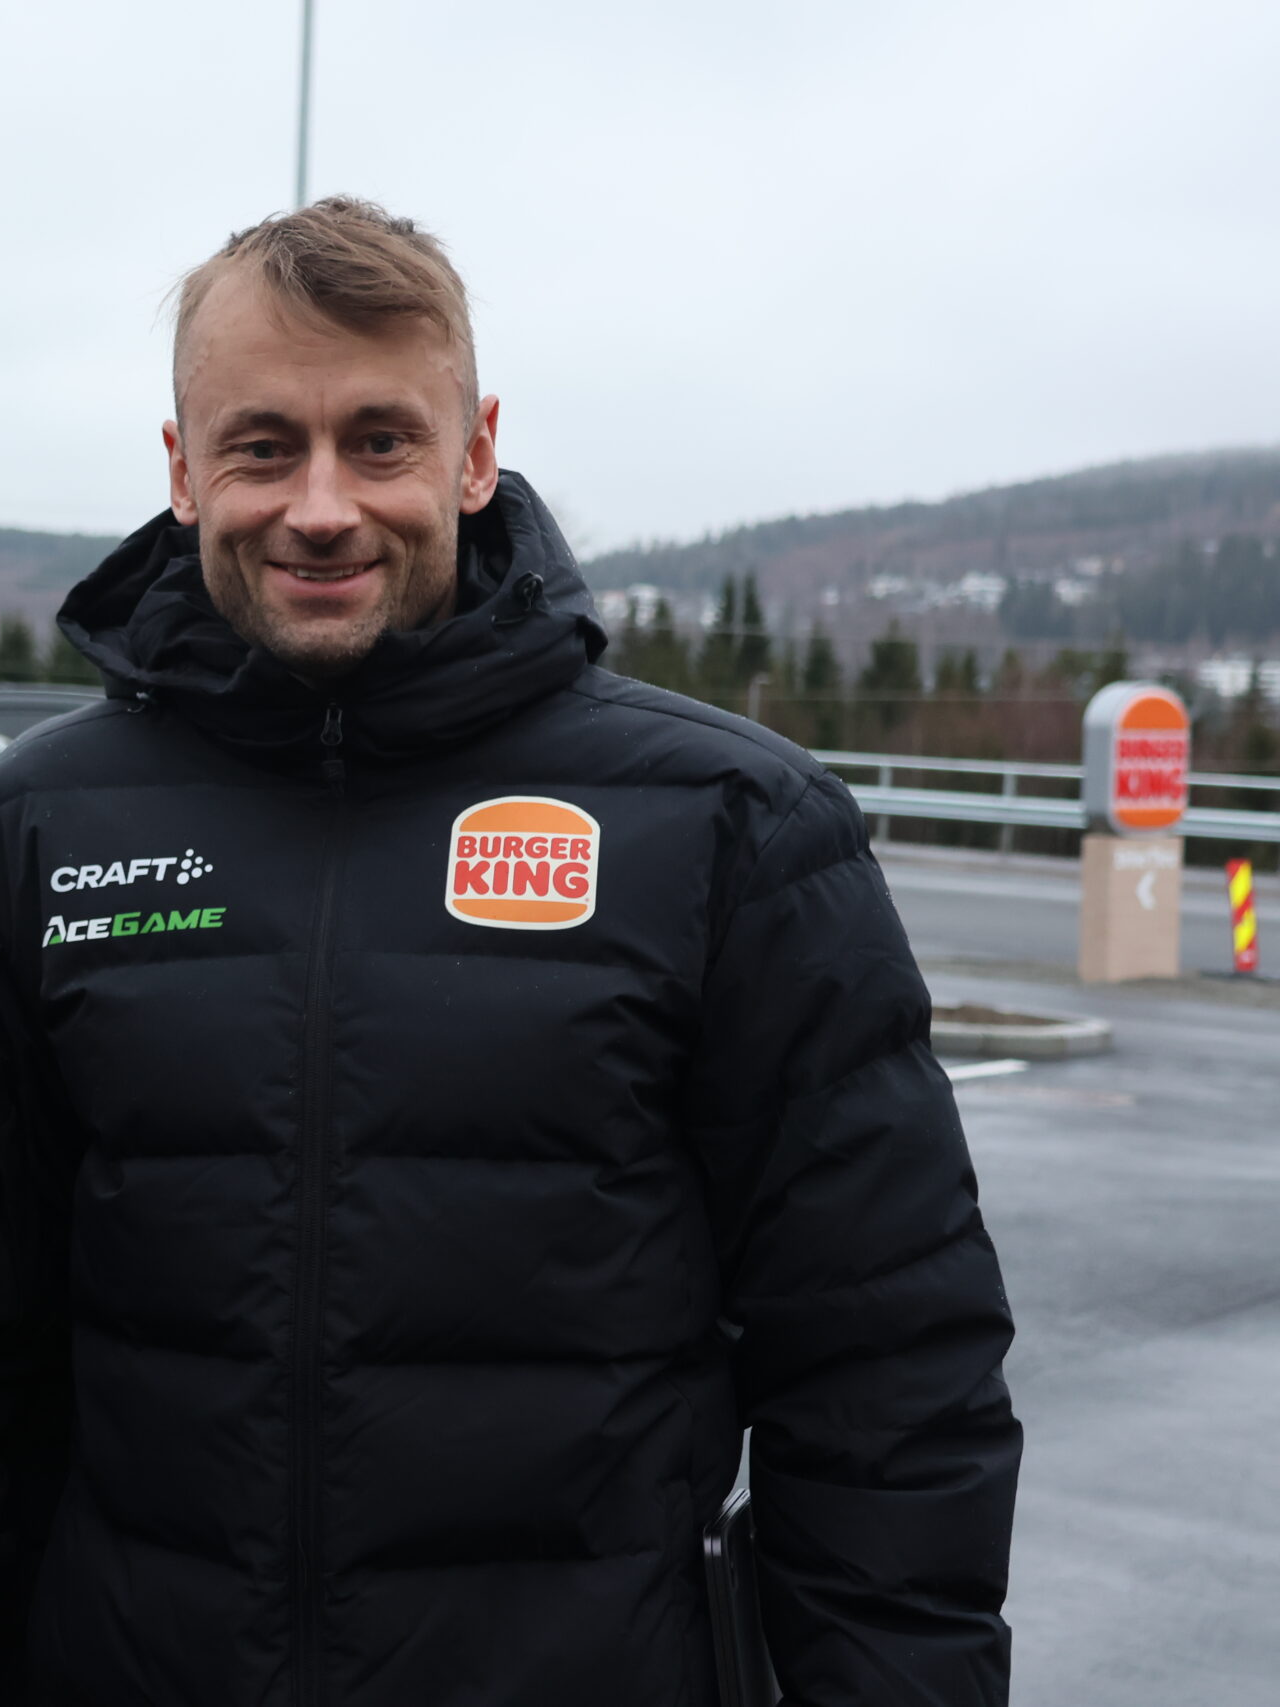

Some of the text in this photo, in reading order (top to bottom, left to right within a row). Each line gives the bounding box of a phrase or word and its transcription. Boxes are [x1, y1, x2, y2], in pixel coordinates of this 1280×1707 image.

[456, 835, 591, 861] BURGER
[50, 856, 178, 893] CRAFT
[453, 860, 589, 899] KING
